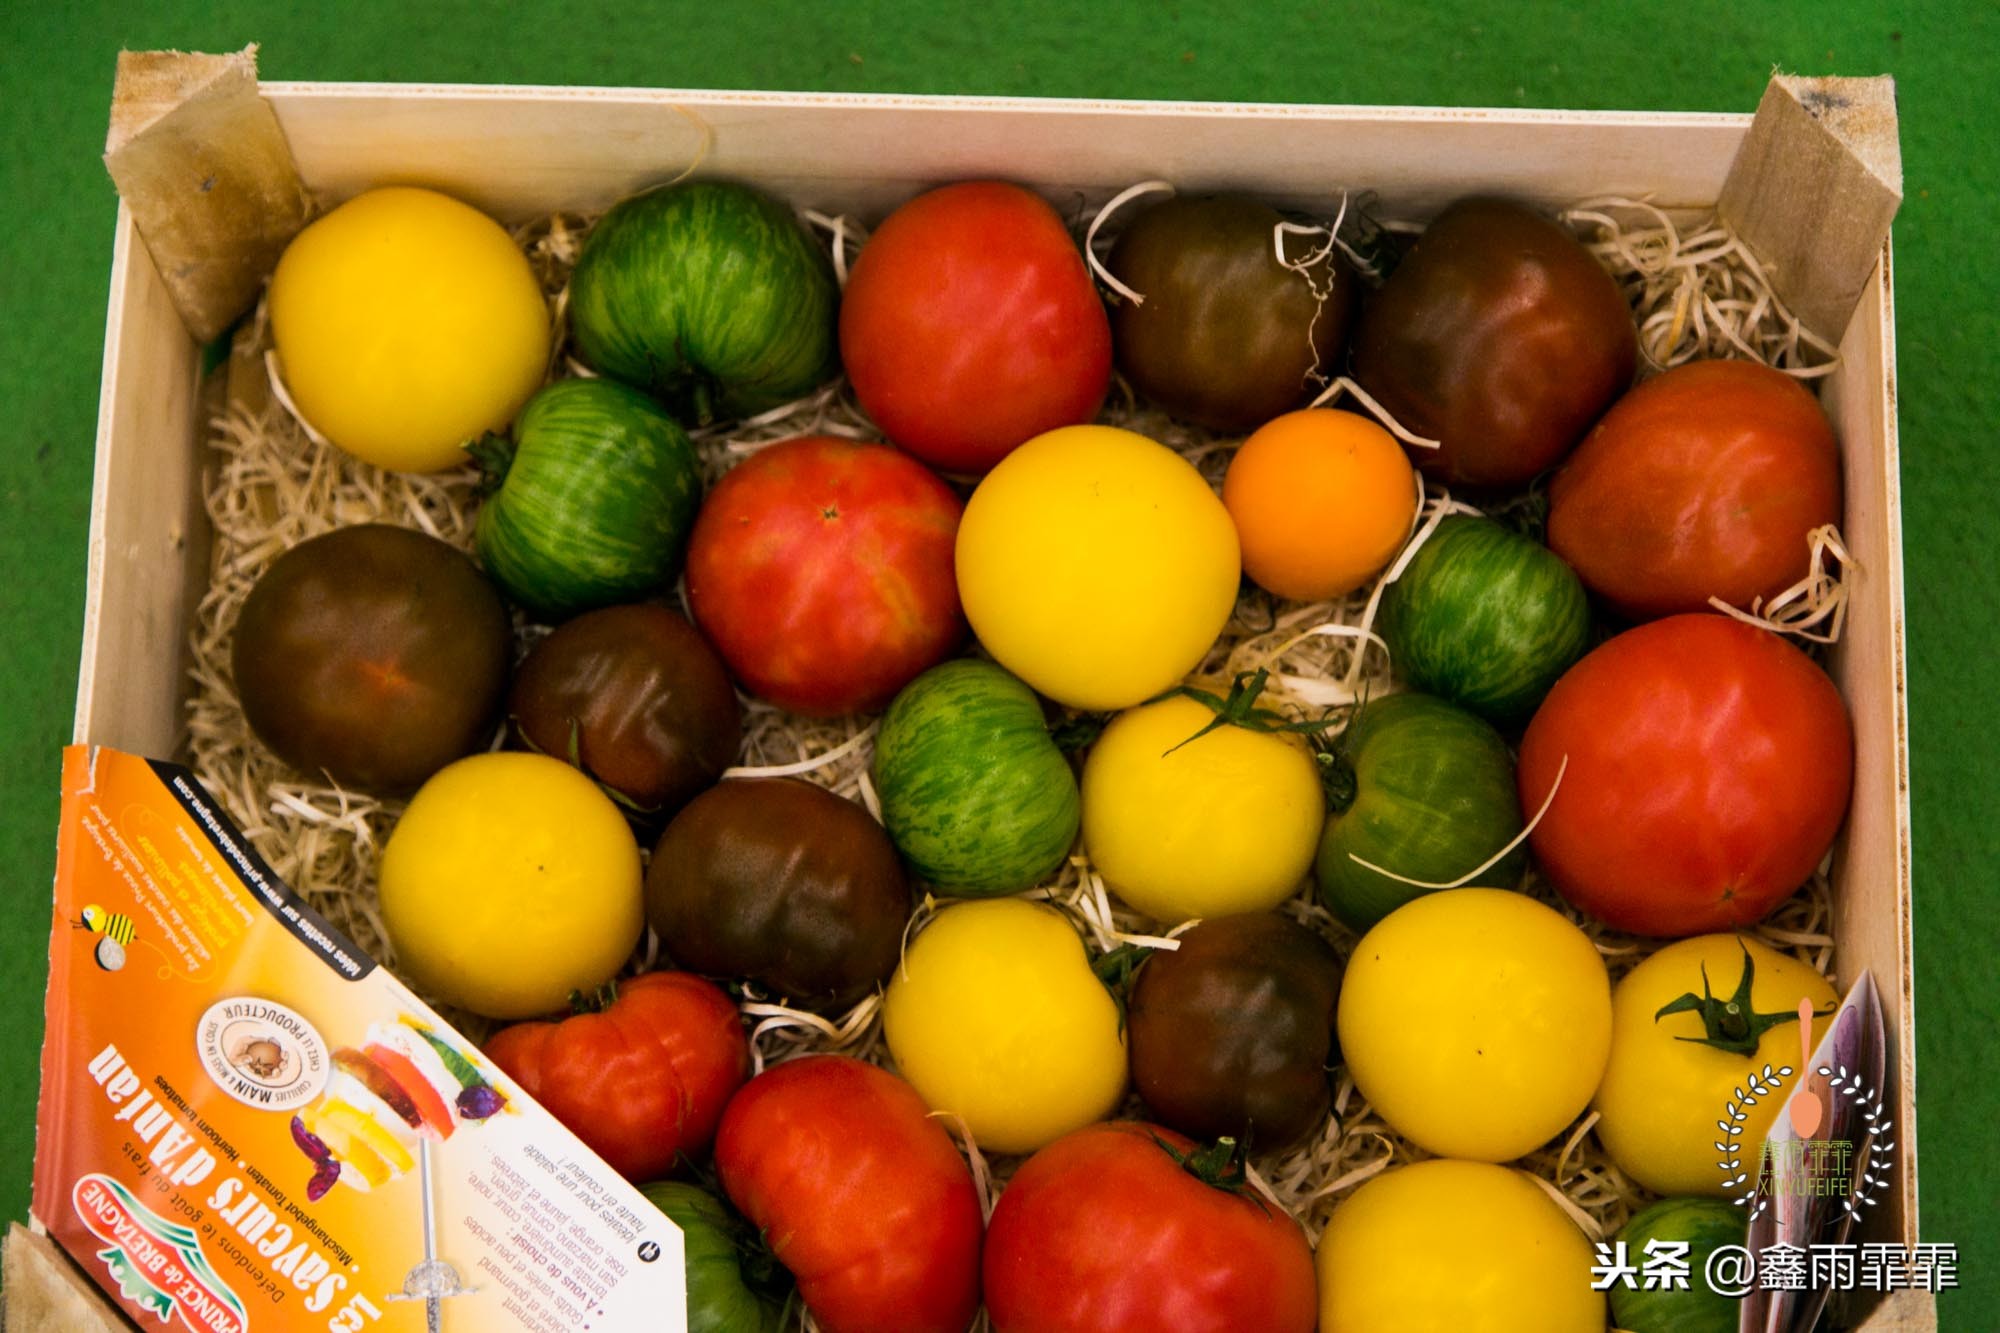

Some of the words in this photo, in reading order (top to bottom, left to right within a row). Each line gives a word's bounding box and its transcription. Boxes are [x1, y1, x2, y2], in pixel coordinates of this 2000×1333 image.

[173, 776, 284, 908] www.princedebretagne.com
[280, 905, 300, 922] sur
[297, 918, 336, 953] recettes
[333, 950, 361, 976] Idées
[223, 1004, 306, 1038] PRODUCTEUR
[302, 1038, 312, 1047] LE
[307, 1050, 319, 1071] CHEZ
[154, 1075, 197, 1121] tomatoes
[233, 1080, 271, 1102] MAIN
[88, 1044, 216, 1186] d'Antan
[196, 1120, 240, 1162] Heirloom
[122, 1142, 150, 1175] frais
[523, 1144, 558, 1174] salade
[151, 1174, 171, 1193] du
[246, 1166, 287, 1207] Tomaten
[555, 1172, 578, 1192] une
[564, 1162, 604, 1194] couleur
[170, 1193, 204, 1223] goût
[527, 1188, 541, 1200] et
[575, 1190, 602, 1212] pour
[601, 1193, 618, 1206] en
[539, 1198, 571, 1224] jaune
[616, 1206, 646, 1233] haute
[82, 1183, 168, 1273] BRETAGNE
[200, 1224, 216, 1240] le
[284, 1202, 352, 1266] Mischangebot
[463, 1216, 496, 1246] acides
[598, 1210, 636, 1244] Idéales
[207, 1178, 347, 1312] Saveurs
[494, 1243, 517, 1264] peu
[511, 1234, 548, 1265] choisir
[162, 1265, 184, 1285] de
[218, 1237, 285, 1303] Défendons
[476, 1256, 531, 1302] gourmand
[512, 1260, 527, 1273] et
[546, 1264, 562, 1278] de
[598, 1268, 618, 1287] san
[561, 1276, 587, 1301] vous
[572, 1266, 608, 1299] tomate
[176, 1280, 239, 1333] PRINCE
[526, 1299, 540, 1311] et
